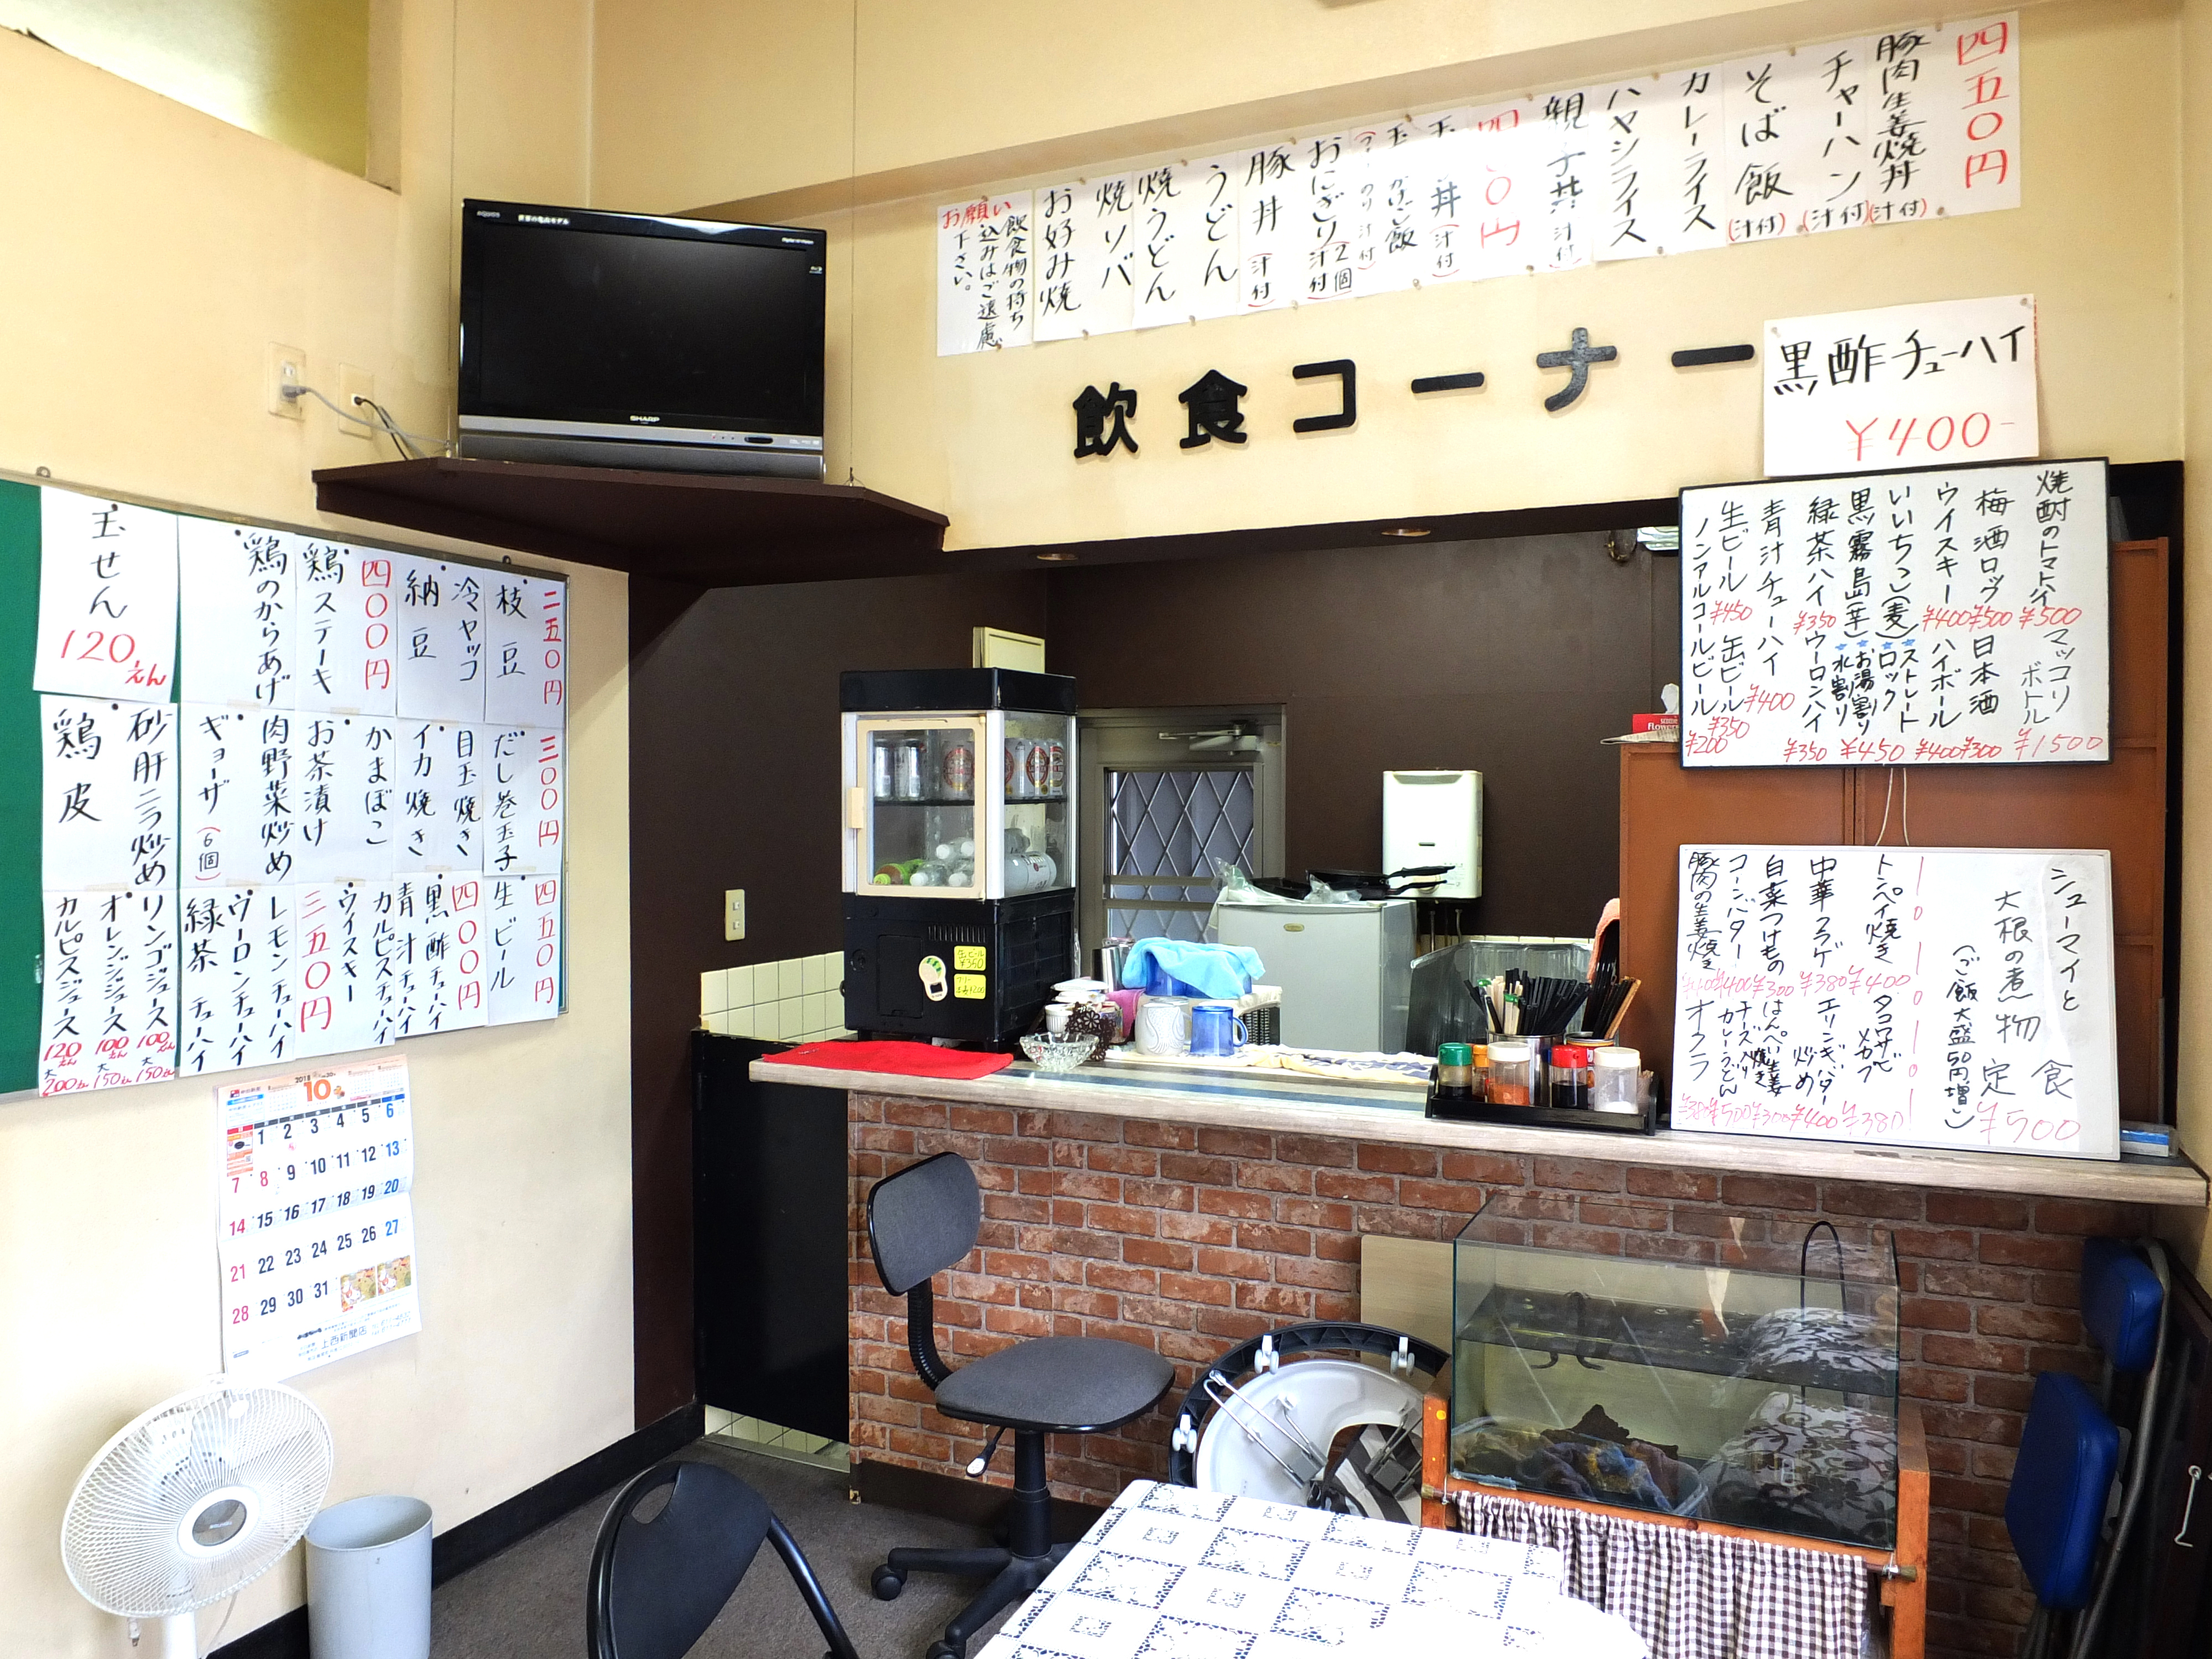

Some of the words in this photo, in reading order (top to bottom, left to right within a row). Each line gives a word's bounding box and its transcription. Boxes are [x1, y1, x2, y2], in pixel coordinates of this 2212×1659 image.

[1683, 70, 1717, 233] カレーライス
[1734, 62, 1794, 207] そば飯
[1821, 49, 1861, 203] チャーハン
[1872, 29, 1930, 194] 豚肉生姜焼丼
[942, 199, 1012, 229] お願い
[1245, 145, 1296, 236] 豚丼
[1307, 136, 1345, 249] おにぎり
[1606, 87, 1647, 247] ハヤシライス
[1001, 213, 1030, 331] 飲食物の持ち
[1040, 190, 1082, 316] お好み焼
[1097, 179, 1134, 290] 焼ソバ
[1138, 166, 1182, 305] 焼うどん
[1204, 164, 1239, 288] うどん
[977, 224, 1003, 351] 込みはご遠慮
[1071, 325, 1756, 458] 飲食コーナー
[1773, 325, 2026, 396] 黒酢チューハイ
[89, 509, 128, 619] 玉せん
[1718, 500, 1749, 592] 生ビール
[1756, 499, 1788, 676] 青汁チューハイ
[1806, 495, 1840, 607] 緑茶ハイ
[1934, 481, 1959, 604] ウイスキー
[1973, 487, 2016, 604] 梅酒ロック
[2029, 469, 2074, 607] 焼酎のトマトハイ
[243, 532, 291, 706] 鶏のからあげ
[302, 542, 345, 695] 鶏ステーキ
[405, 568, 440, 661] 納豆
[451, 576, 481, 682] 冷ヤッコ
[496, 583, 528, 679] 枝豆
[1691, 517, 1720, 716] ノンアルコールビール
[1710, 599, 1753, 625] ¥450
[1793, 611, 1837, 635] ¥350
[1922, 604, 1972, 632] ¥400
[1969, 604, 2013, 633] ¥500
[2019, 605, 2083, 630] ¥500
[1720, 635, 1746, 713] 缶ビール
[1744, 683, 1796, 714] ¥400
[1802, 630, 1827, 733] ウーロンハイ
[1831, 654, 1854, 727] 水割り
[1851, 648, 1877, 736] お湯割り
[1879, 651, 1900, 712] ロック
[1900, 648, 1919, 733] ストレート
[1929, 638, 1963, 728] ハイボール
[1969, 634, 2001, 716] 日本酒
[2021, 660, 2051, 725] ボトル
[2043, 628, 2077, 713] マッコリ
[53, 708, 103, 824] 鶏皮
[197, 713, 231, 816] ギョーザ
[1685, 730, 1728, 757] ¥200
[1708, 717, 1750, 739] ¥350
[1783, 738, 1827, 763] ¥350
[1840, 737, 1905, 762] ¥450
[2014, 728, 2104, 761] ¥1500
[126, 707, 174, 887] 砂肝ニラ炒め
[260, 714, 295, 883] 肉野菜炒め
[302, 719, 336, 847] お茶漬け
[365, 726, 394, 846] かまぼこ
[405, 723, 436, 857] イカ焼き
[453, 729, 481, 857] 目玉焼き
[493, 730, 518, 872] だし巻玉子
[338, 888, 359, 1003] ウイスキー
[395, 881, 418, 1035] 青汁チューハイ
[425, 883, 450, 1031] 黒酢チューハイ
[489, 880, 517, 993] 生ビール
[1727, 854, 1756, 959] コーンバター
[2051, 868, 2088, 1011] シューマイと
[53, 896, 84, 1040] カルピスジュース
[100, 894, 129, 1036] オレンジジュース
[142, 894, 173, 1030] リンゴジュース
[184, 896, 226, 1072] 緑茶チューハイ
[228, 893, 256, 1067] ウーロンチューハイ
[267, 895, 293, 1060] レモンチューハイ
[373, 891, 396, 1045] カルピスチューハイ
[1752, 974, 1794, 999] ¥300
[1799, 970, 1847, 997] ¥380
[1848, 964, 1911, 996] ¥400
[1994, 890, 2041, 1044] 大根の煮物
[1685, 999, 1715, 1082] オクラ
[1817, 998, 1846, 1105] エリンギバター
[1873, 994, 1902, 1072] タコワサビ
[258, 1129, 264, 1145] 1
[283, 1123, 293, 1140] 2
[310, 1118, 319, 1134] 3
[336, 1113, 345, 1128] 4
[361, 1108, 370, 1124] 5
[386, 1103, 394, 1119] 6
[303, 1078, 332, 1103] 10
[1790, 1103, 1838, 1132] ¥400
[1842, 1100, 1904, 1137] ¥380
[1976, 1101, 2081, 1145] ¥500
[229, 1218, 246, 1237] 14
[257, 1211, 273, 1229] 15
[284, 1204, 300, 1222] 16
[311, 1197, 327, 1214] 17
[337, 1191, 351, 1207] 18
[361, 1184, 375, 1201] 19
[384, 1178, 399, 1196] 20
[231, 1177, 240, 1194] 7
[259, 1170, 269, 1187] 8
[286, 1164, 296, 1181] 9
[310, 1157, 327, 1175] 10
[336, 1152, 351, 1169] 11
[361, 1145, 377, 1163] 12
[385, 1140, 400, 1157] 13
[230, 1264, 246, 1282] 21
[258, 1255, 275, 1275] 22
[285, 1247, 302, 1267] 23
[311, 1240, 327, 1259] 24
[337, 1232, 352, 1251] 25
[361, 1225, 377, 1244] 26
[385, 1218, 399, 1237] 27
[232, 1305, 249, 1325] 28
[260, 1296, 277, 1316] 29
[287, 1287, 304, 1307] 30
[313, 1280, 328, 1299] 31
